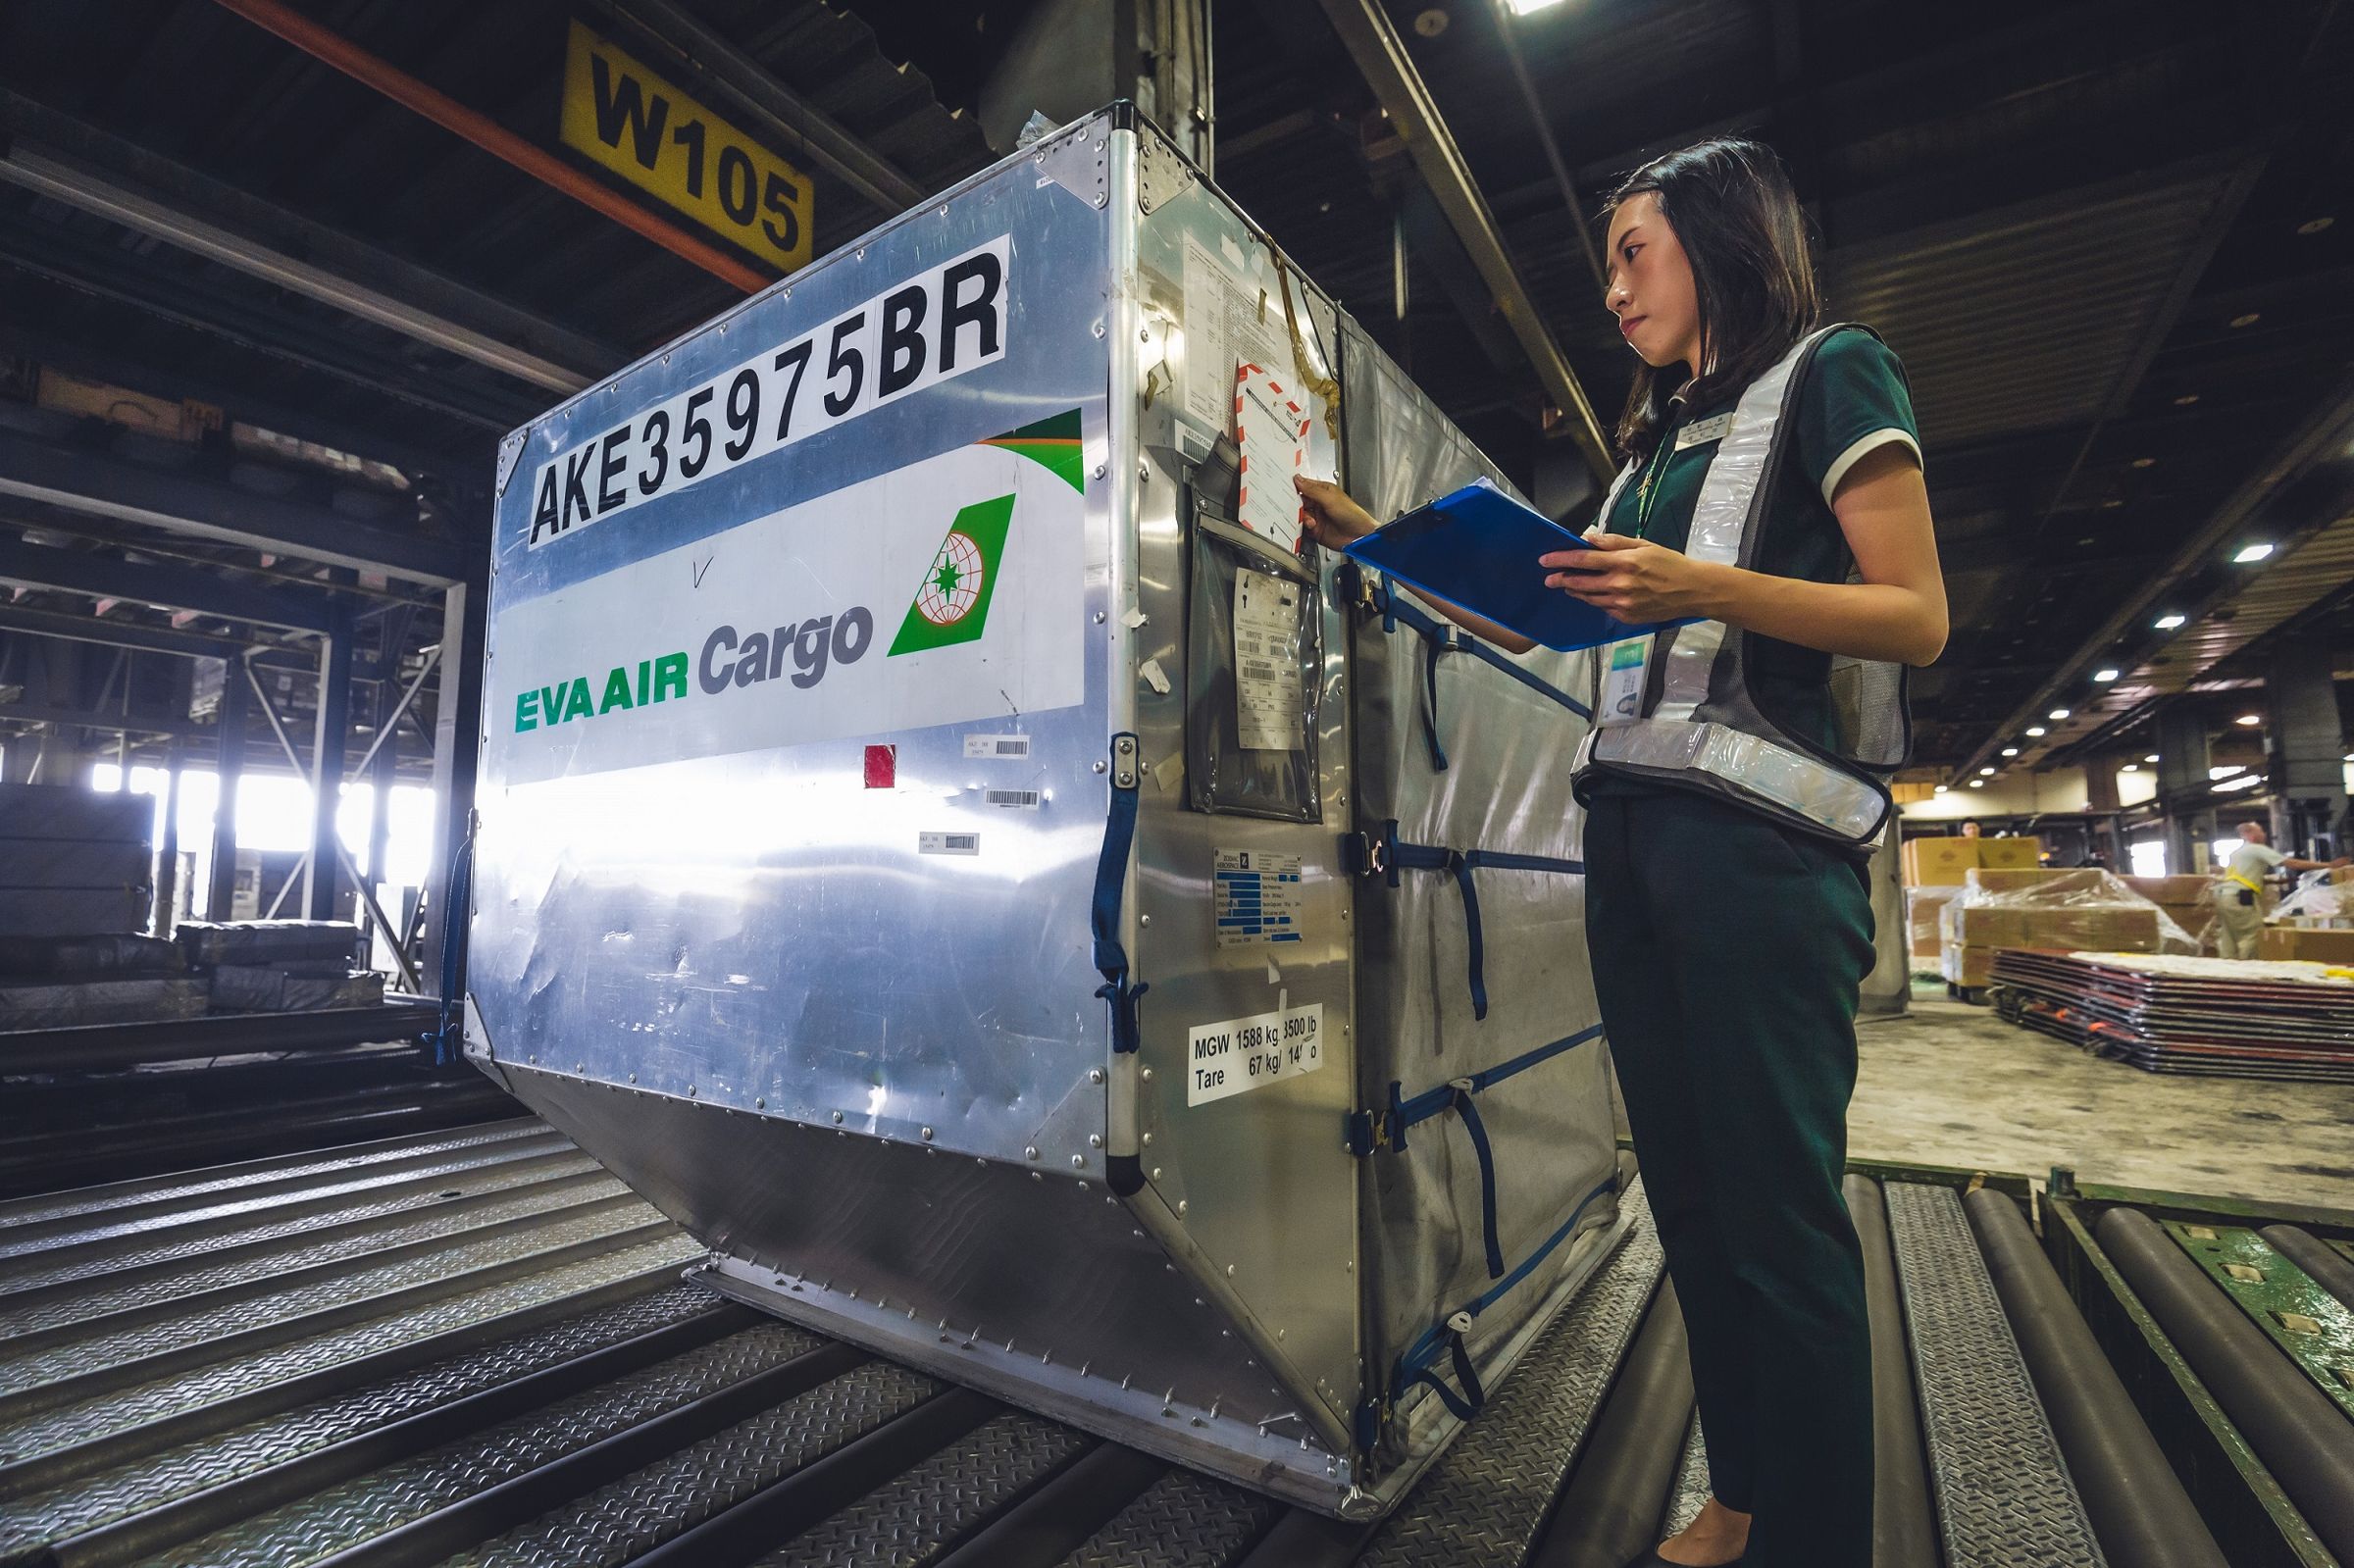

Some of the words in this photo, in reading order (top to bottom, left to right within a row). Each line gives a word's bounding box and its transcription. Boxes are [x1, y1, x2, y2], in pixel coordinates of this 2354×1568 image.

[590, 52, 798, 252] W105
[530, 252, 1002, 545] AKE35975BR
[515, 677, 594, 733] EVA
[599, 651, 690, 715] AIR
[698, 606, 874, 695] Cargo
[1195, 1034, 1230, 1060] MGW
[1236, 1027, 1262, 1050] 1588
[1265, 1026, 1279, 1047] kg
[1284, 1017, 1305, 1039] 3500
[1307, 1015, 1316, 1033] lb
[1196, 1069, 1224, 1090] Tare
[1249, 1055, 1262, 1077] 67
